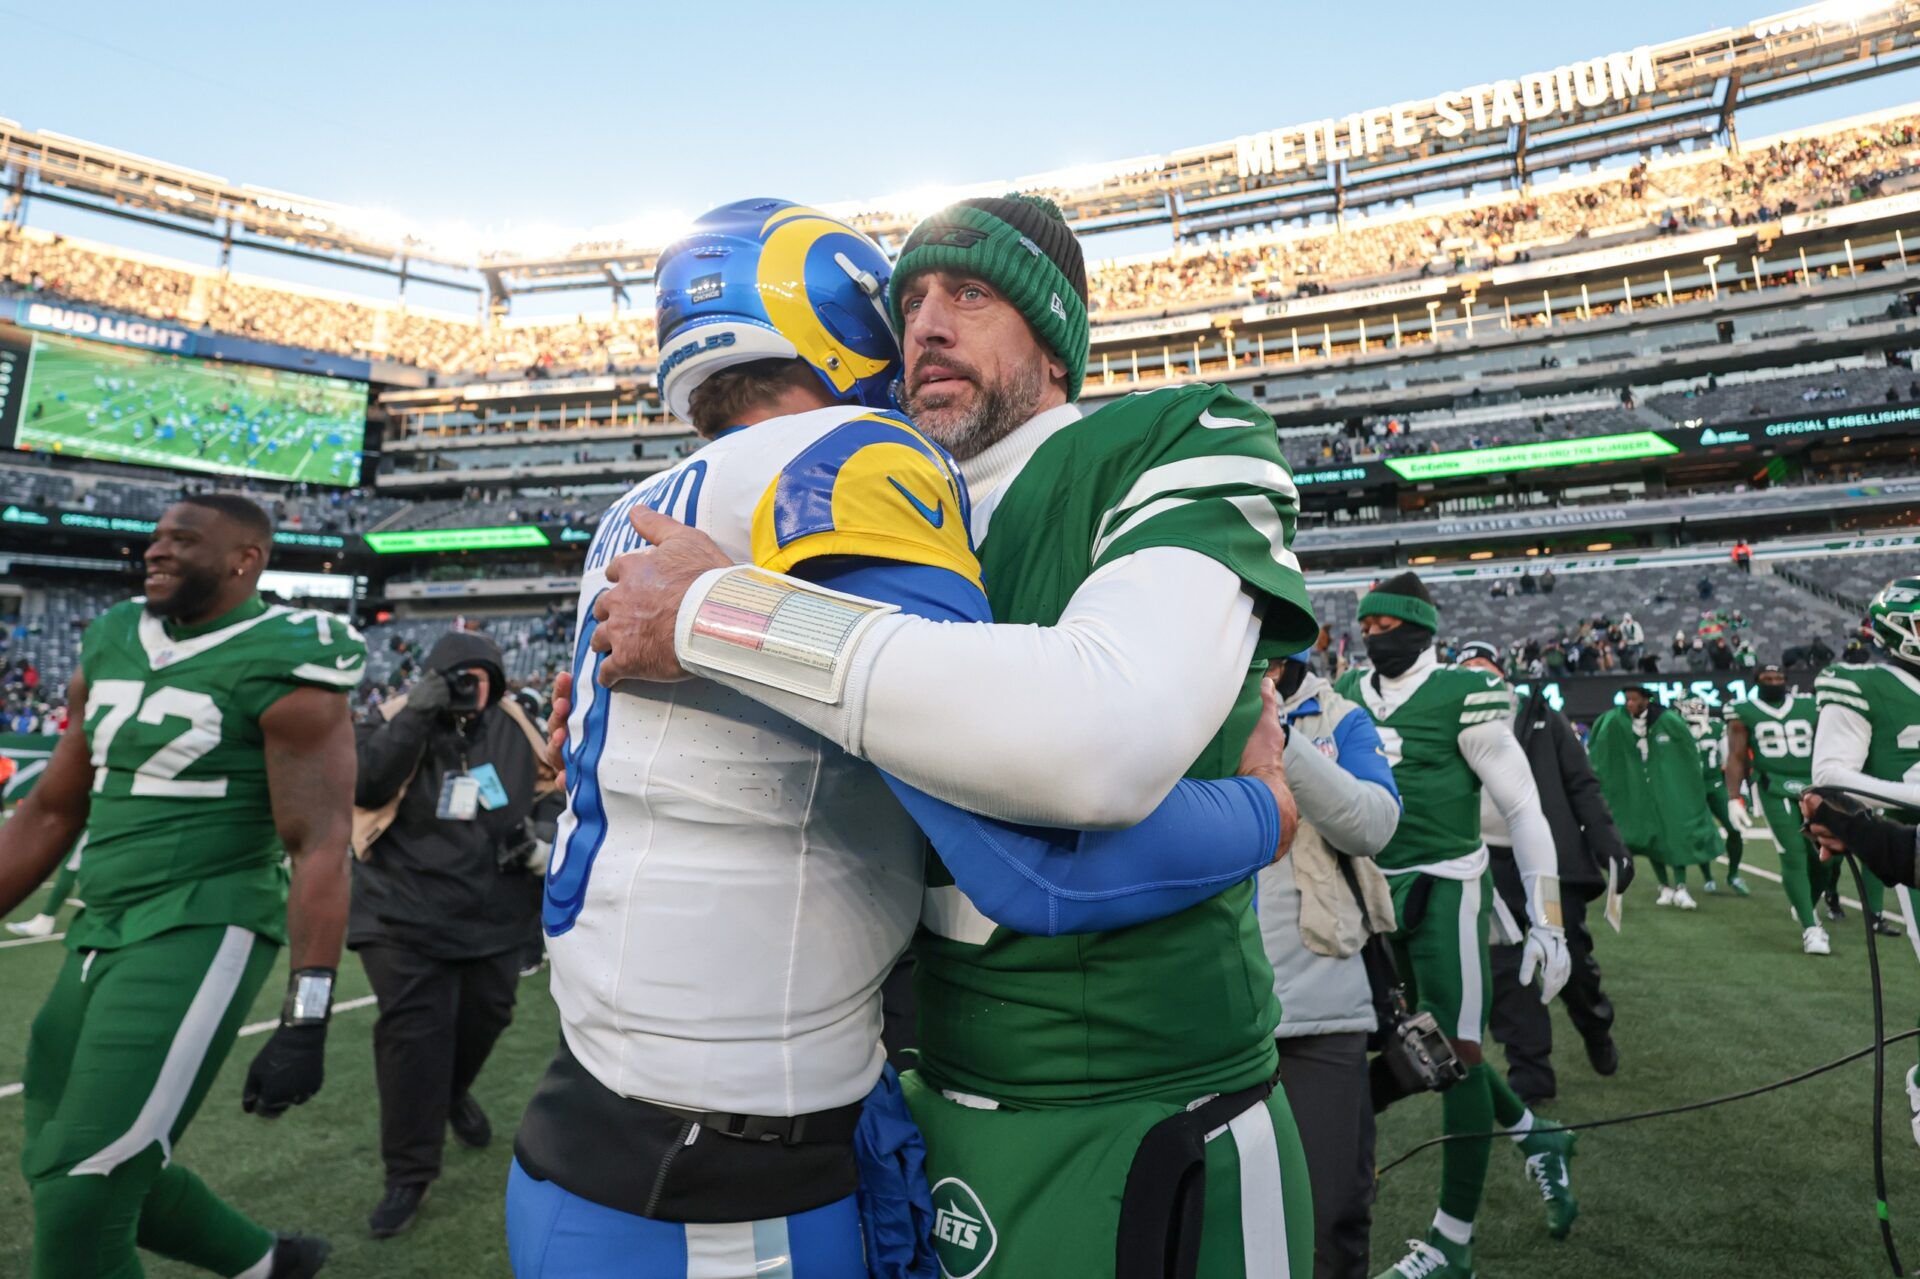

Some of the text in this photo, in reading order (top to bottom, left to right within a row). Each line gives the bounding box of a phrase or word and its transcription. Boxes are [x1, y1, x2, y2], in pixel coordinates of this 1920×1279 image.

[1236, 44, 1657, 178] METLIFE STADIUM
[28, 303, 188, 350] BUD LIGHT
[1765, 421, 1826, 437] OFFICIAL
[1314, 473, 1341, 484] YORK
[1341, 468, 1366, 481] JETS
[1437, 508, 1628, 534] METLIFE STADIUM
[84, 679, 229, 797] 72
[1754, 719, 1814, 759] 88
[932, 1202, 982, 1251] JETS
